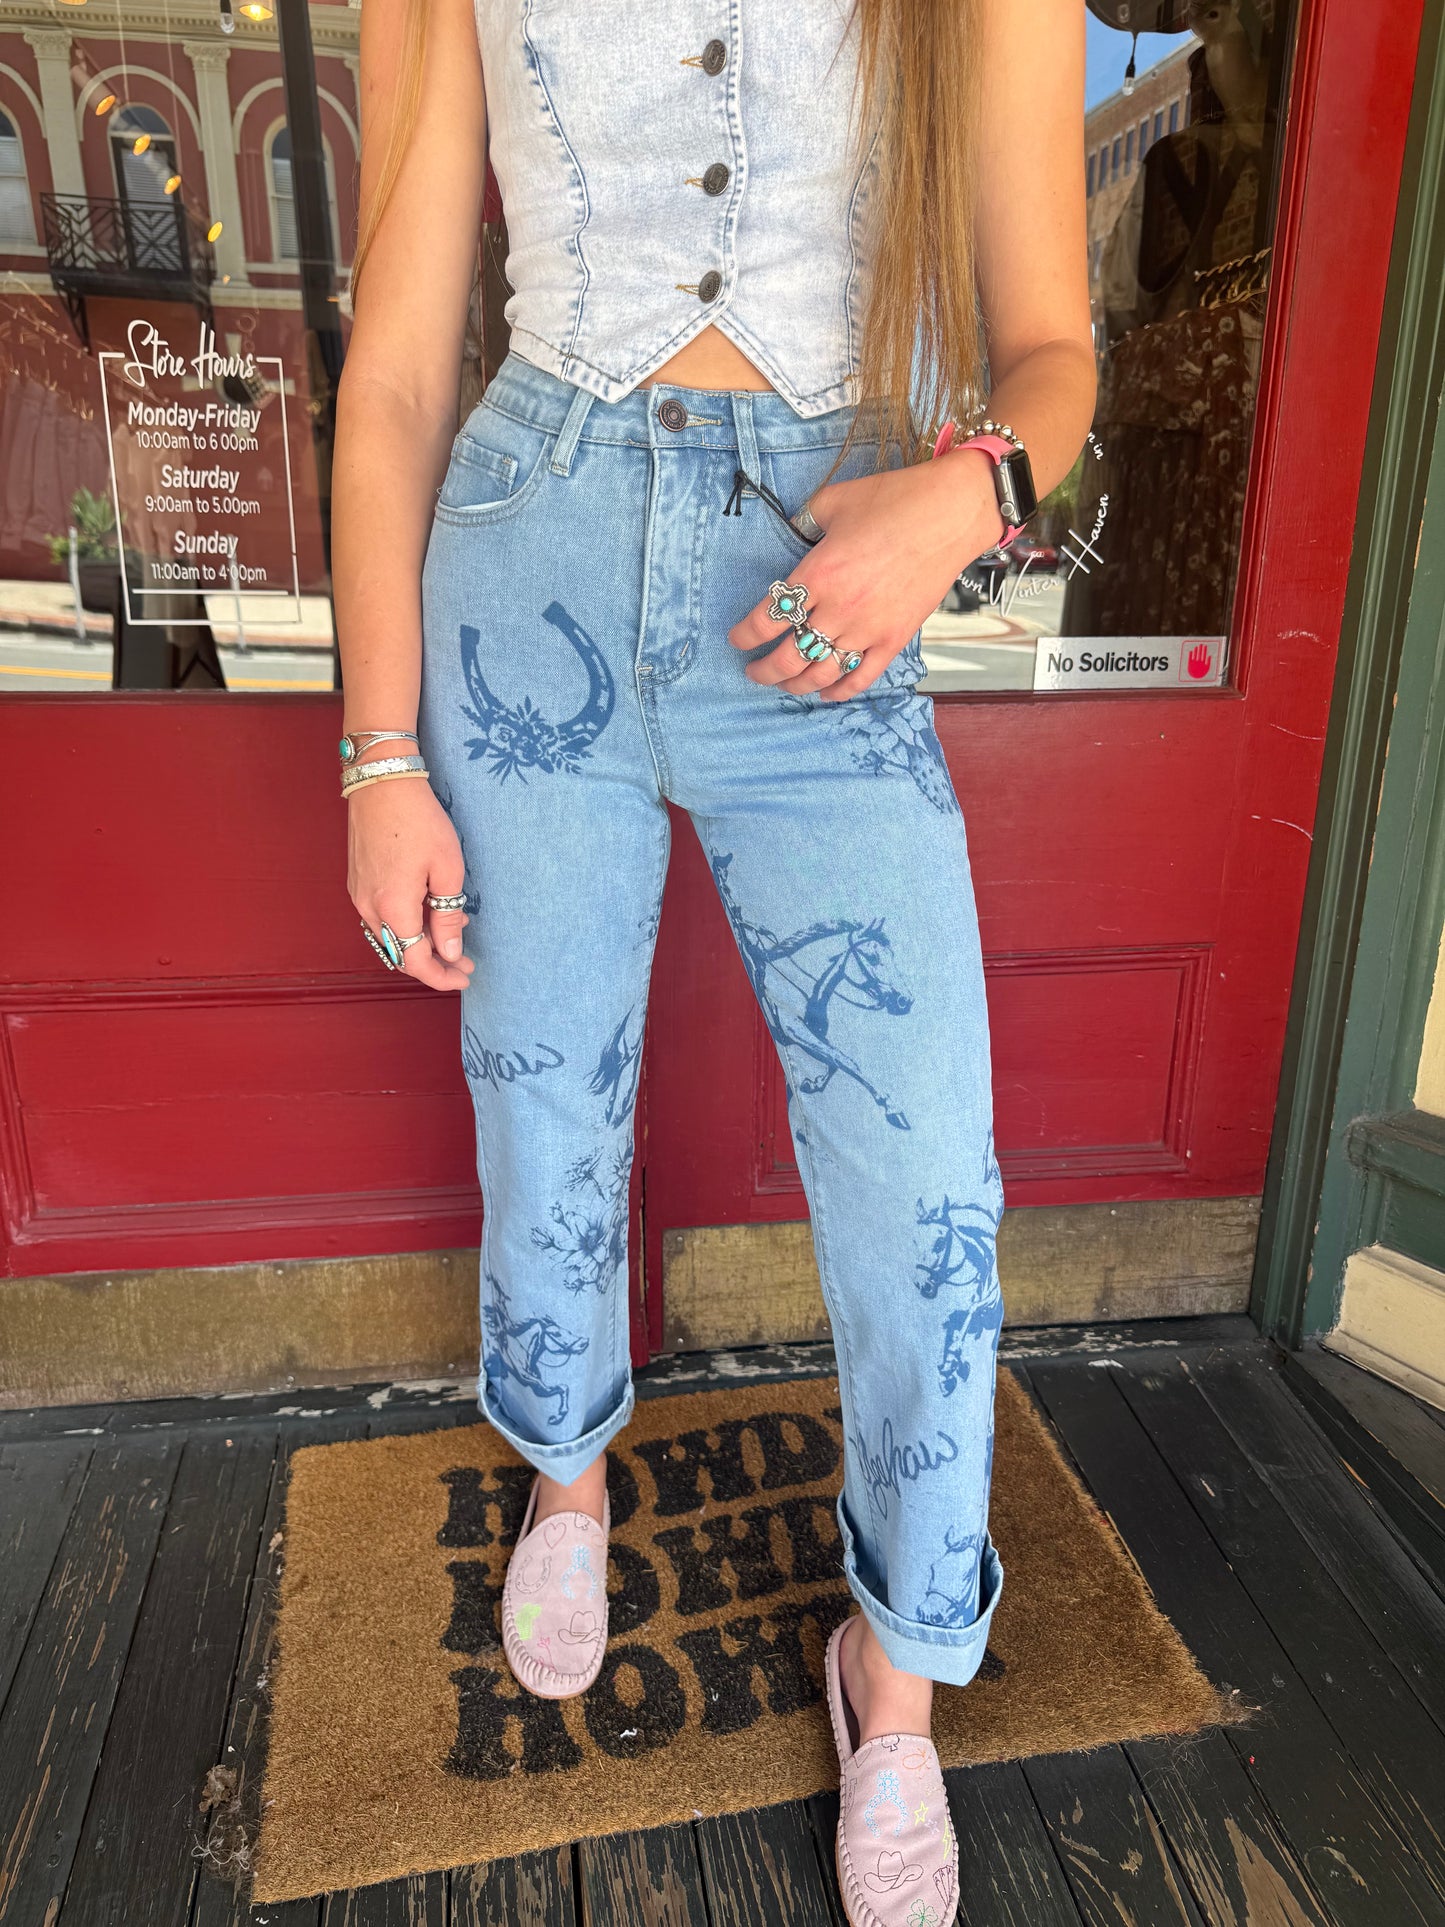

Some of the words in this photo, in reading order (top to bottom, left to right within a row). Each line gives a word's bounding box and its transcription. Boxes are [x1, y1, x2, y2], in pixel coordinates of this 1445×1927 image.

[124, 320, 187, 387] Store
[190, 320, 256, 389] Hours
[127, 401, 261, 433] Monday-Friday
[136, 431, 190, 449] 10:00am
[193, 433, 207, 450] to
[160, 464, 240, 493] Saturday
[145, 495, 194, 513] 9:00am
[196, 496, 210, 514] to
[174, 530, 239, 558] Sunday
[989, 550, 1060, 617] Winter
[1060, 493, 1110, 581] Haven
[151, 562, 200, 581] 11:00am
[202, 564, 216, 580] to
[1047, 652, 1074, 673] No
[1078, 651, 1169, 672] Solicitors
[438, 1407, 843, 1549] HWD
